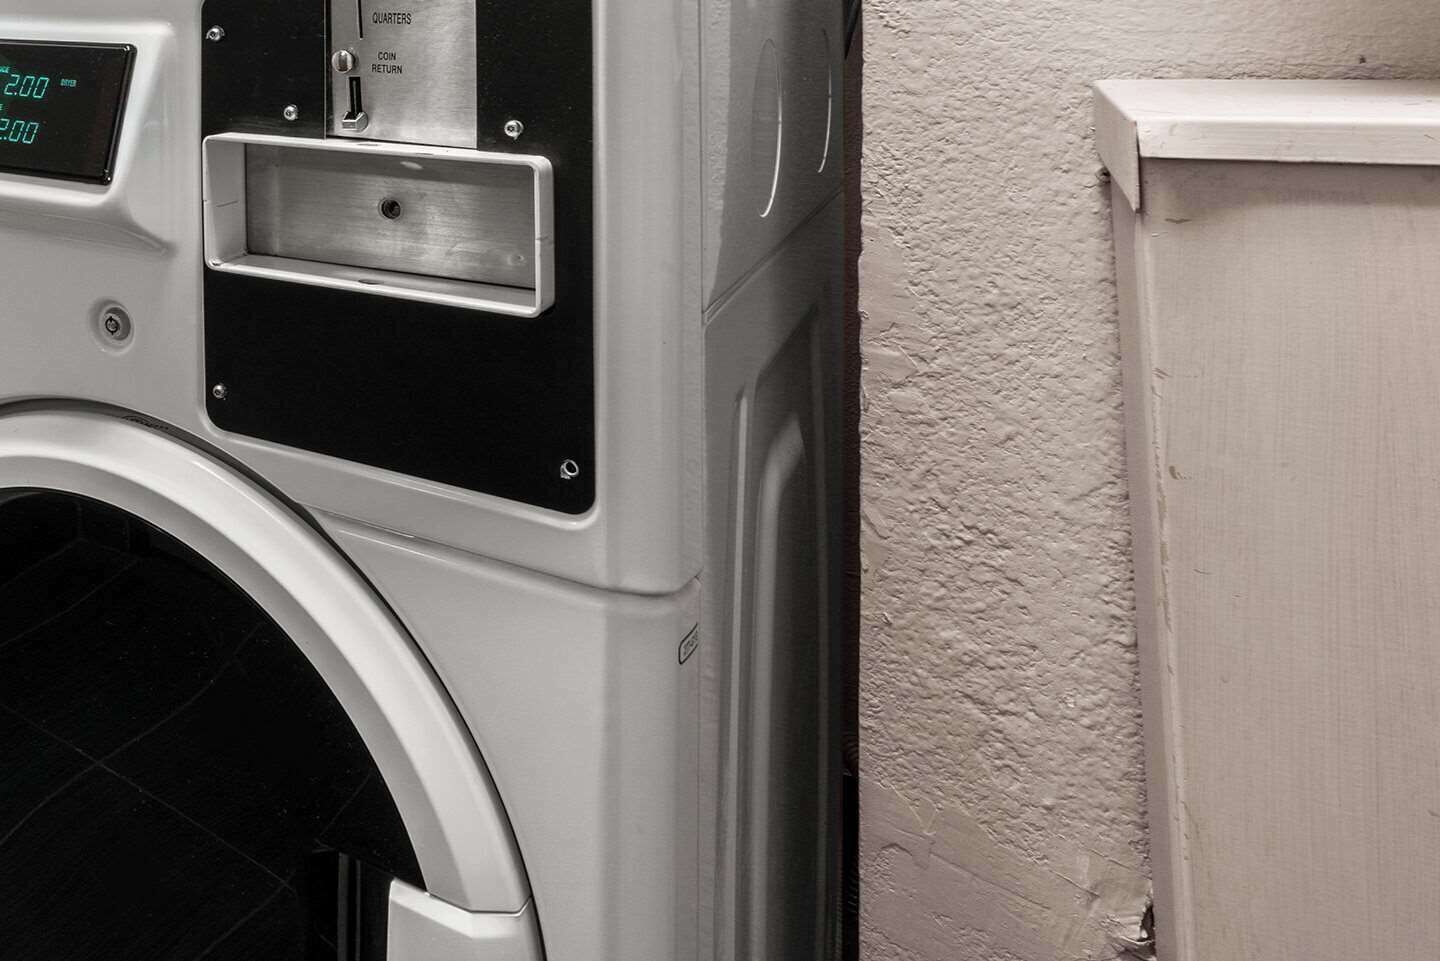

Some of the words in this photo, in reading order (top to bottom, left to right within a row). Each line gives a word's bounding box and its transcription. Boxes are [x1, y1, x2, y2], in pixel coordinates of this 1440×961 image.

[371, 11, 412, 25] QUARTERS
[377, 51, 397, 61] COIN
[371, 63, 403, 74] RETURN
[3, 73, 50, 98] 2.00
